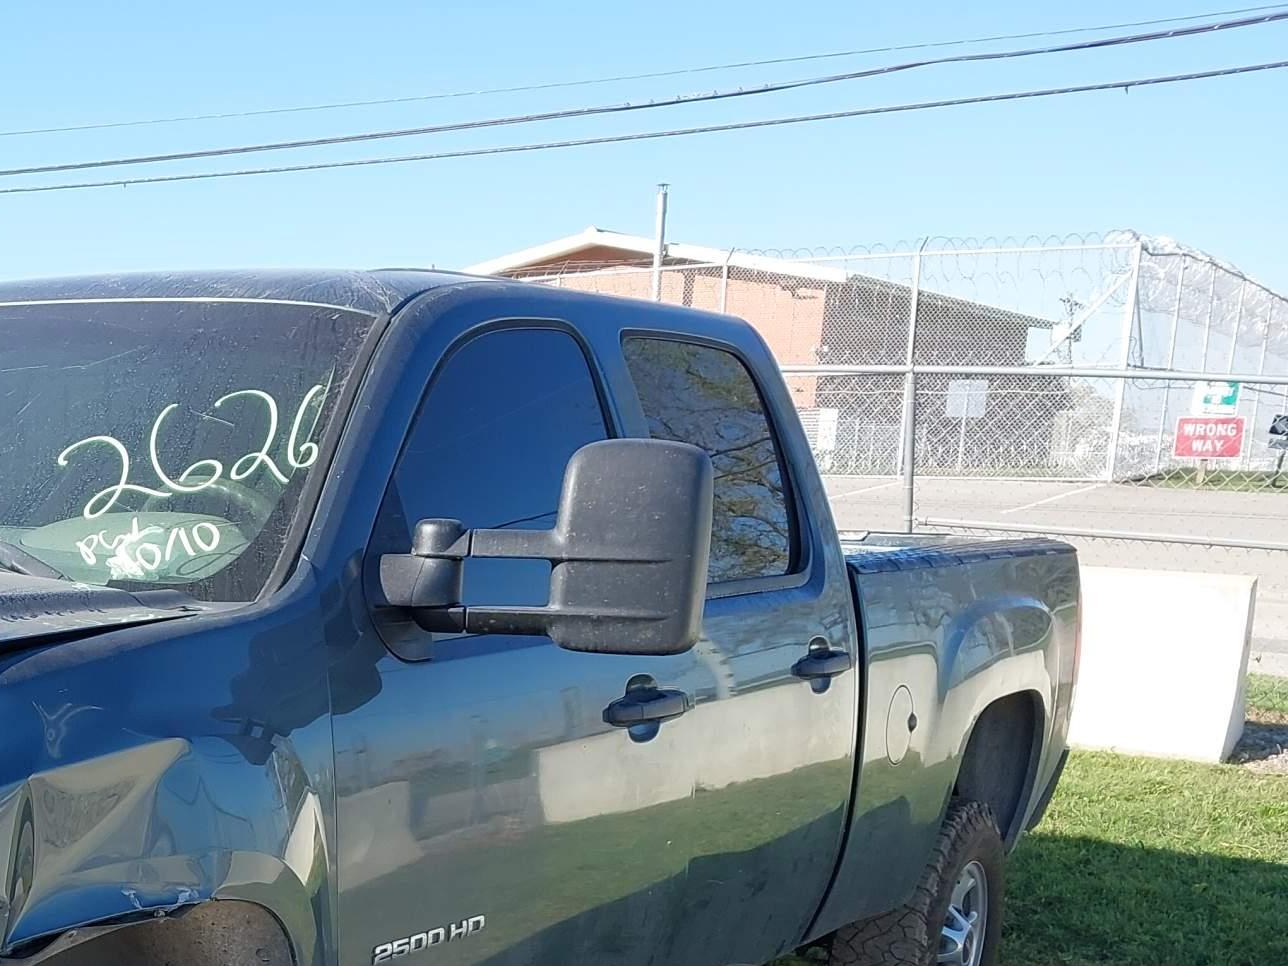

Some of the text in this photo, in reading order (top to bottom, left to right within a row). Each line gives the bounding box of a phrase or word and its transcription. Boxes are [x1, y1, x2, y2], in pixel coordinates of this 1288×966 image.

[1183, 423, 1237, 437] WRONG
[1191, 439, 1225, 453] WAY
[57, 384, 324, 519] 2626
[371, 914, 486, 966] 2500 HD
